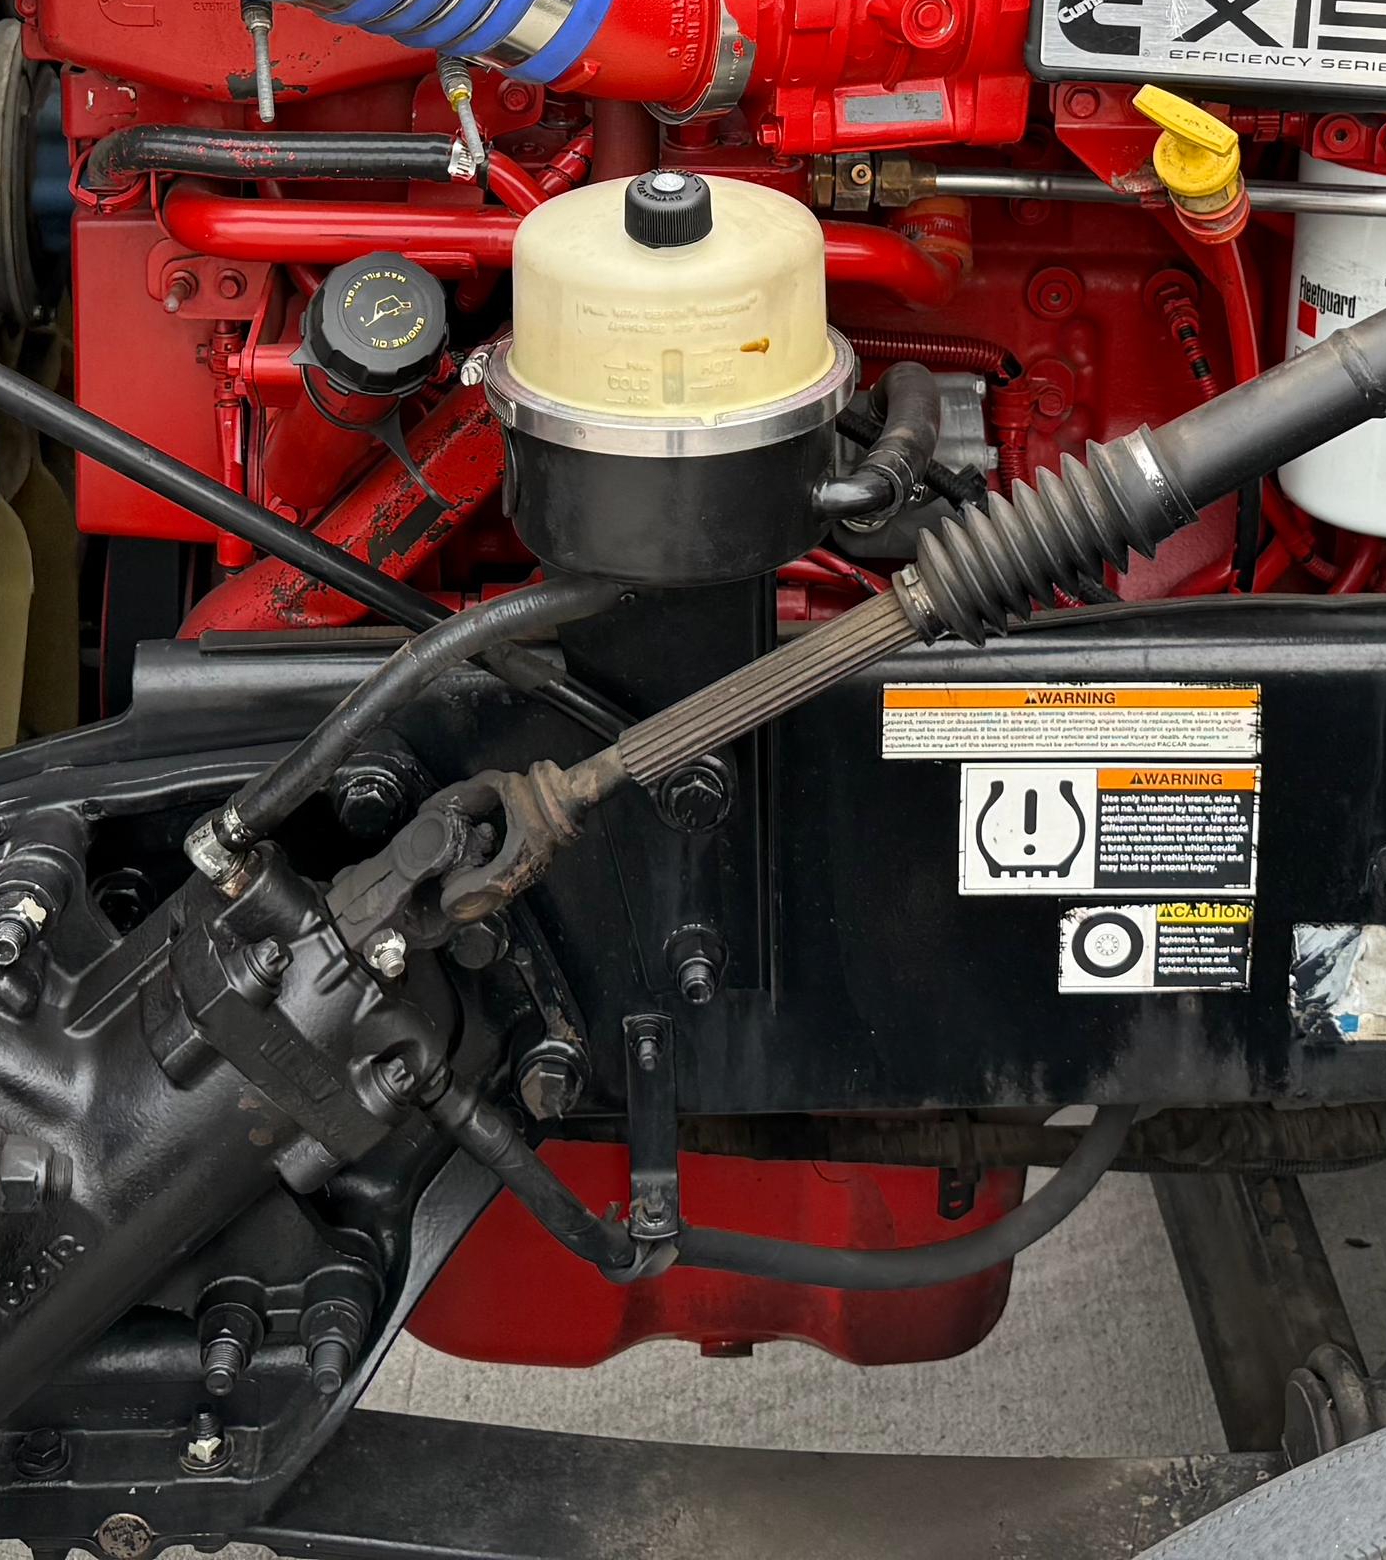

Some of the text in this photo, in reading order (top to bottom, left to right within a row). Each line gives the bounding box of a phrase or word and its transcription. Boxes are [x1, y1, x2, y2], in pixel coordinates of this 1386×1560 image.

[686, 21, 701, 39] IN
[1169, 49, 1313, 68] EFFICIENCY
[362, 271, 381, 281] FILL
[384, 271, 406, 283] MAX
[1299, 274, 1357, 319] Fleetguard
[371, 316, 425, 349] ENGINE OIL
[607, 375, 651, 391] COLD
[1038, 692, 1116, 704] WARNING
[1144, 773, 1223, 785] WARNING
[1101, 794, 1119, 802] Use
[1120, 794, 1139, 804] only
[1141, 794, 1156, 802] the
[1157, 794, 1183, 802] wheel
[1184, 794, 1212, 804] brand,
[1233, 794, 1240, 802] &
[1101, 804, 1119, 814] part
[1136, 804, 1174, 812] installed
[1175, 804, 1187, 814] by
[1187, 804, 1202, 812] the
[1203, 804, 1237, 814] original
[1100, 814, 1147, 824] equipment
[1148, 814, 1208, 822] manufacturer.
[1210, 814, 1228, 822] Use
[1229, 814, 1239, 822] of
[1100, 824, 1138, 832] different
[1138, 824, 1165, 832] wheel
[1165, 824, 1192, 832] brand
[1223, 824, 1249, 832] could
[1128, 834, 1151, 842] valve
[1152, 834, 1175, 842] stem
[1176, 834, 1185, 842] to
[1186, 834, 1223, 842] interfere
[1224, 834, 1243, 842] with
[1107, 844, 1133, 852] brake
[1133, 844, 1183, 854] component
[1183, 844, 1210, 852] which
[1211, 844, 1236, 852] could
[1100, 853, 1243, 862] lead to loss of vehicle control and
[1099, 863, 1217, 873] may lead to personal injury.
[1174, 906, 1247, 918] CAUTION
